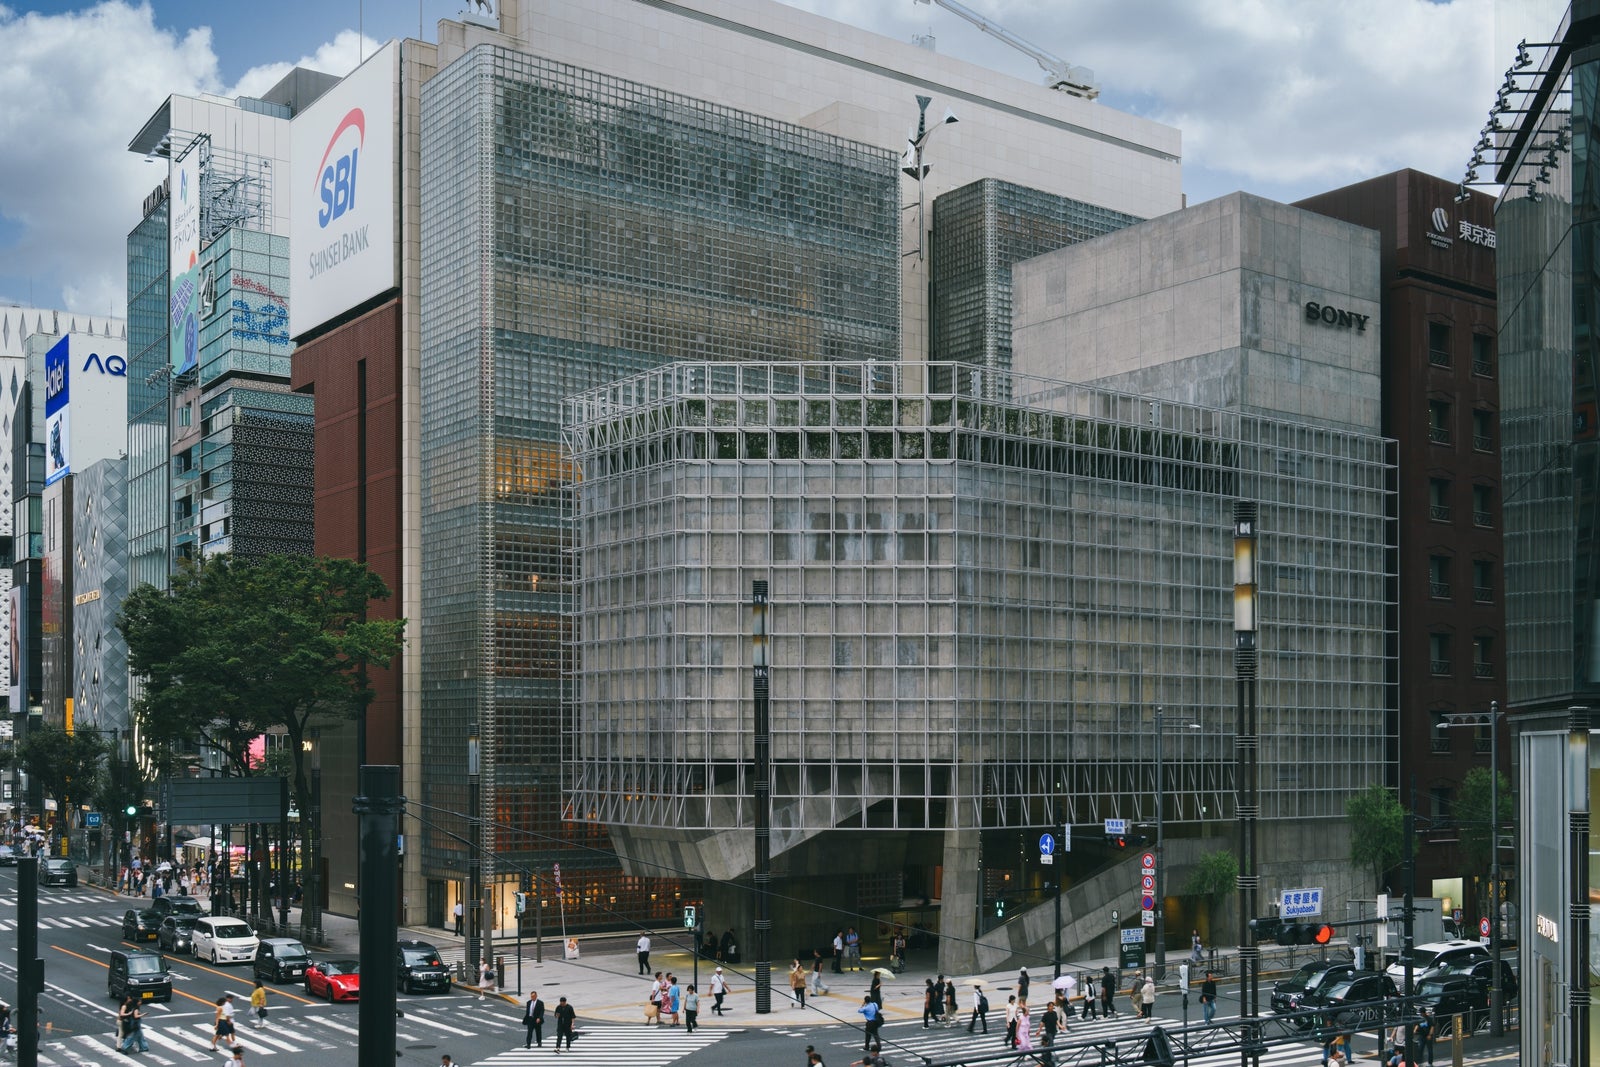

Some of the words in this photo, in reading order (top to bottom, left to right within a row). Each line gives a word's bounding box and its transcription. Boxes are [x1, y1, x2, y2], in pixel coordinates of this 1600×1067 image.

[318, 147, 359, 229] SBI
[309, 239, 341, 280] SHINSEI
[342, 223, 370, 262] BANK
[1305, 301, 1370, 331] SONY
[46, 357, 65, 400] Haier
[1286, 904, 1316, 915] Sukiyabashi
